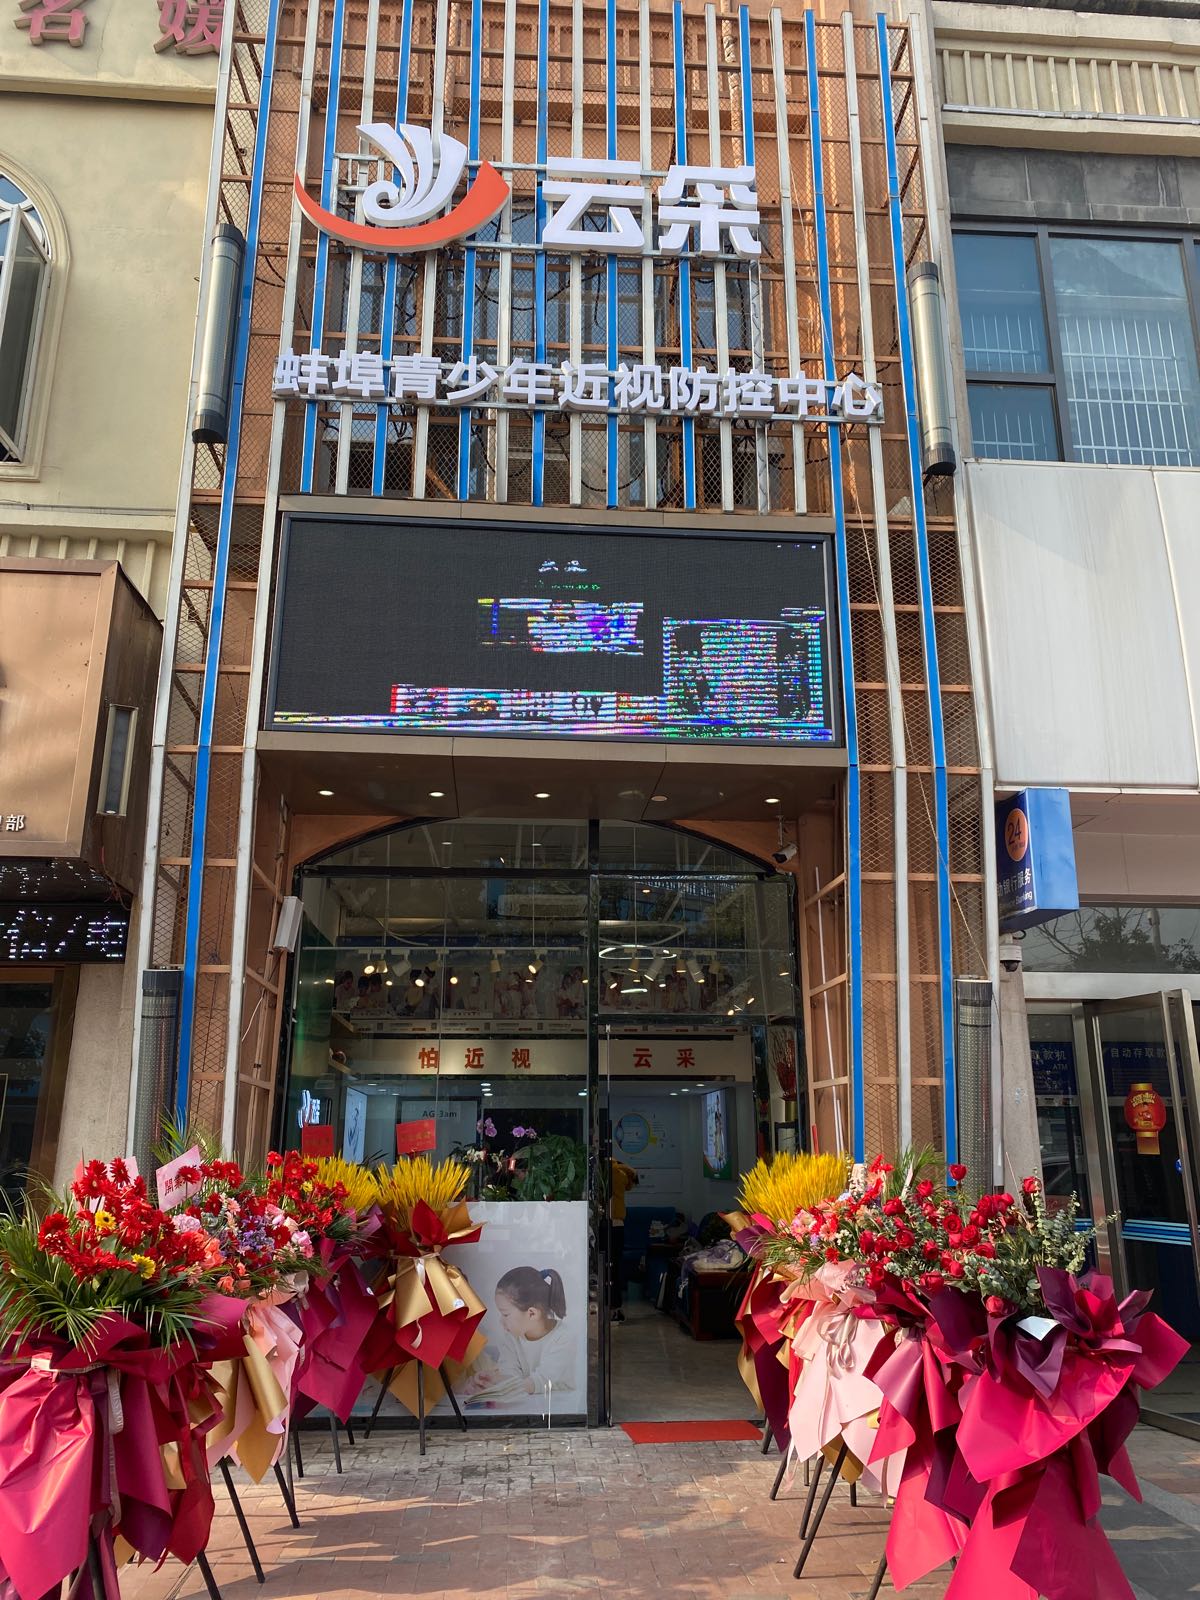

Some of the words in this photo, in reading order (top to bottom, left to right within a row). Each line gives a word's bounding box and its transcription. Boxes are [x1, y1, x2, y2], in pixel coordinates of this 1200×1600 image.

[273, 348, 882, 421] 蚌埠青少年近视防控中心
[0, 813, 26, 833] 部
[1007, 817, 1022, 845] 24
[419, 1047, 532, 1070] 怕近视
[632, 1047, 696, 1069] 云采
